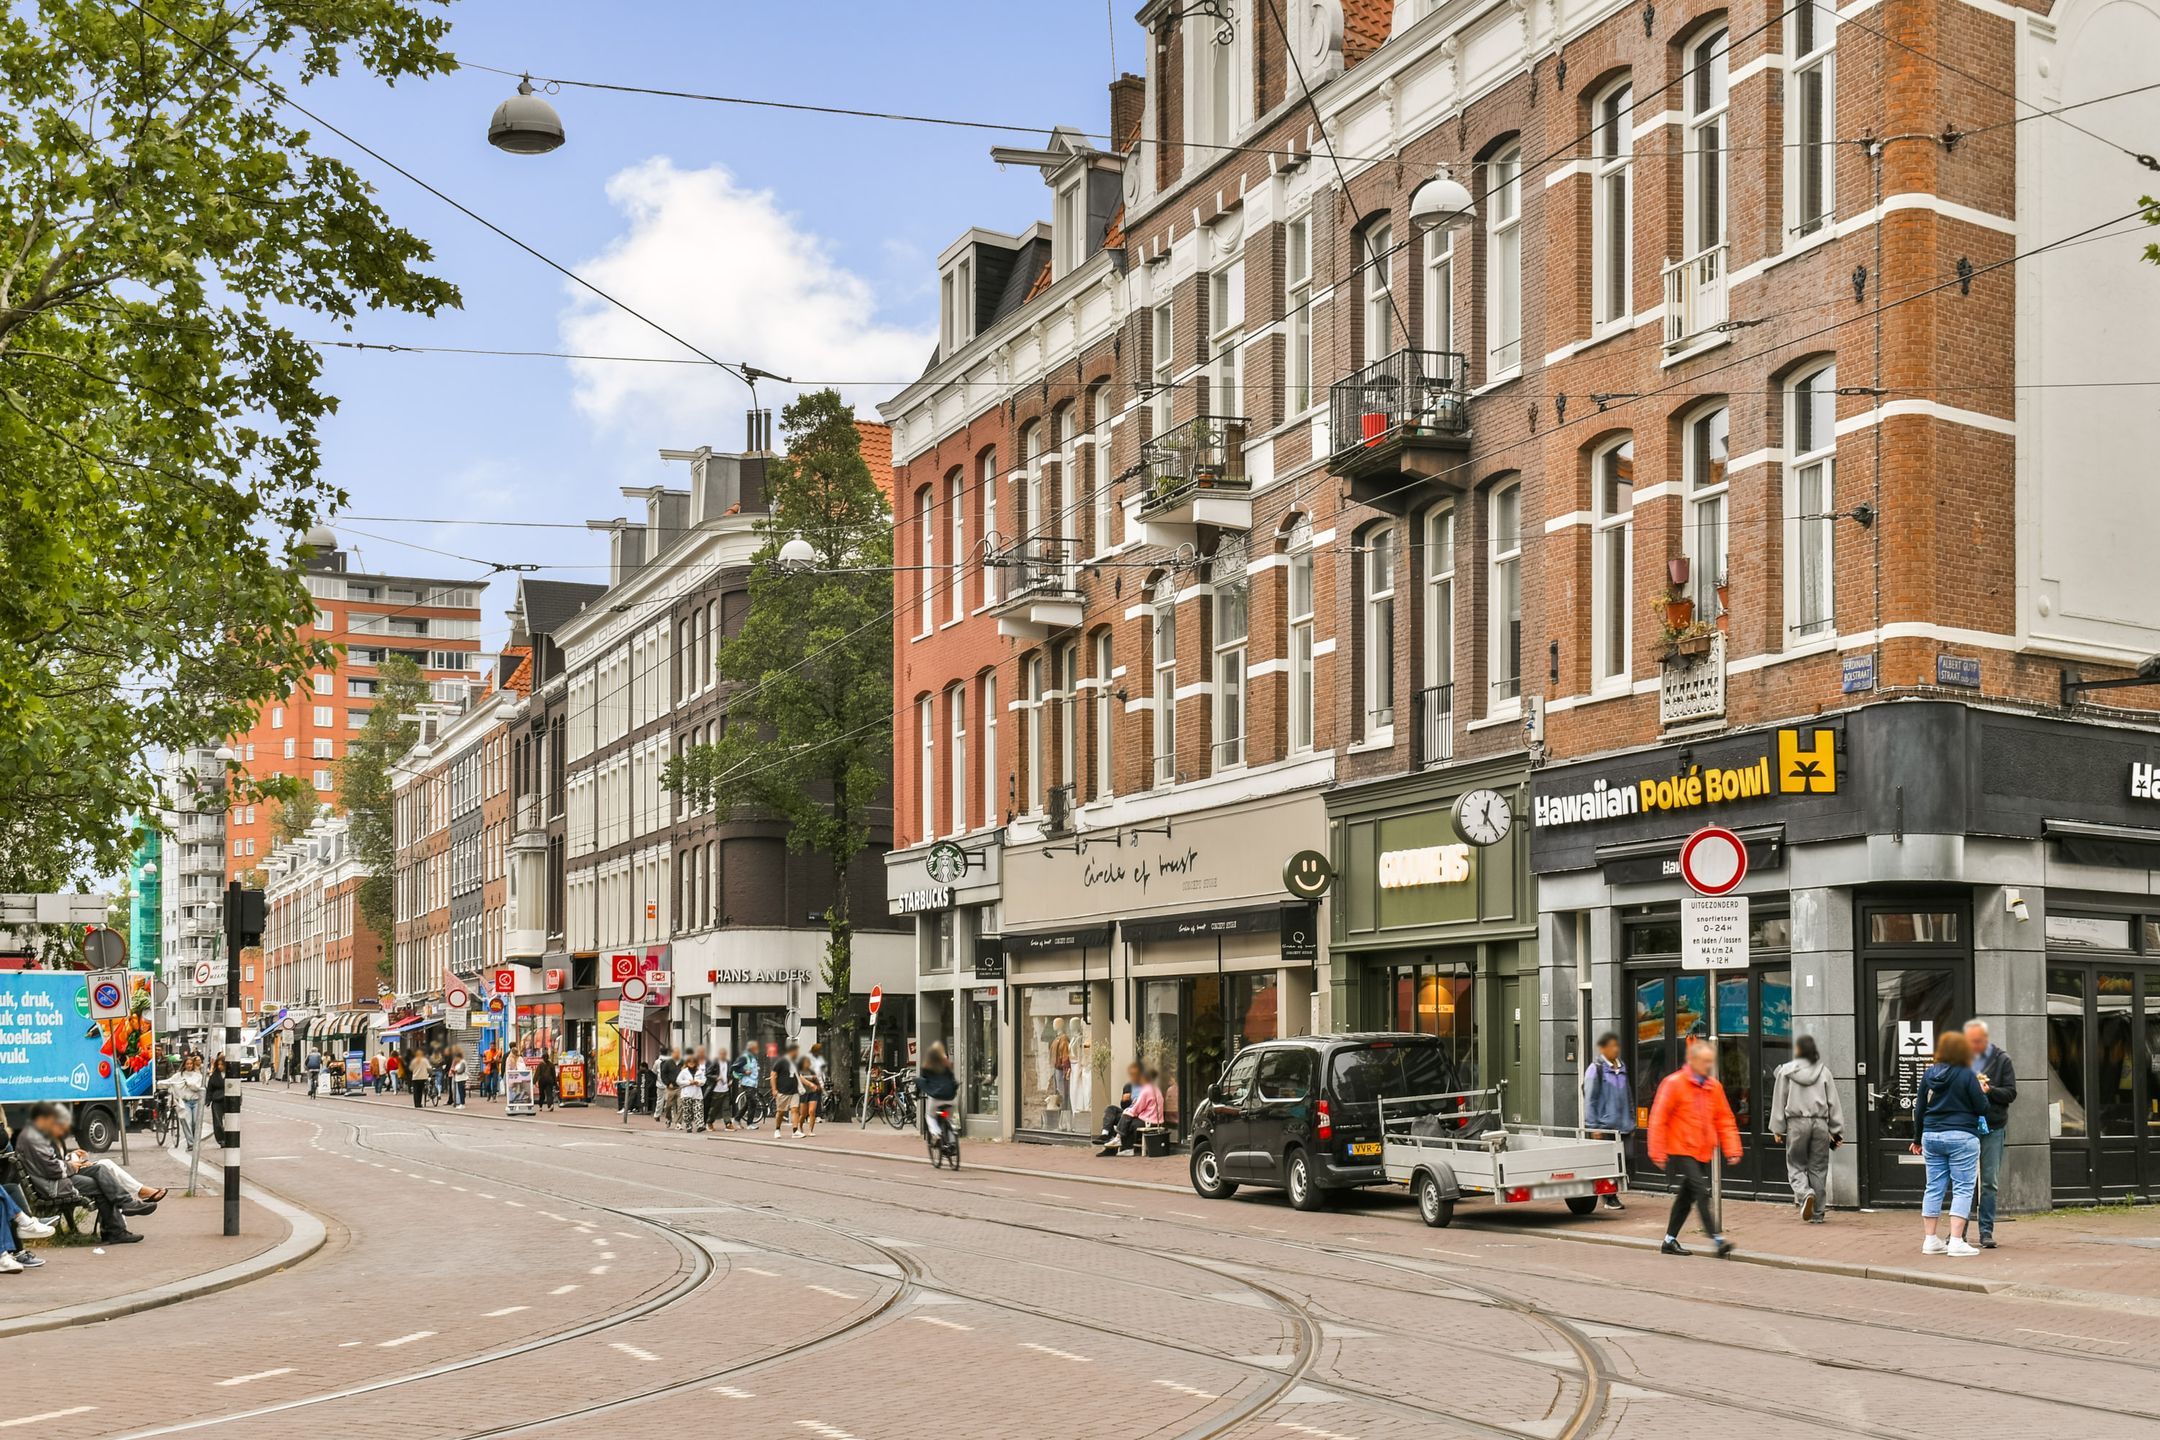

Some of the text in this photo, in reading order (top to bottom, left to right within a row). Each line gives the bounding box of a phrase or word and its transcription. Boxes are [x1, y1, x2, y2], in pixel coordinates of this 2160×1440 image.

[1843, 658, 1871, 671] FERDINAND
[1942, 659, 1977, 672] ALBERT CUYP
[1844, 669, 1870, 682] BOLSTRAAT
[1941, 670, 1960, 680] STRAAT
[1640, 764, 1702, 813] Poké
[1704, 756, 1771, 803] Bowl
[1084, 846, 1198, 895] Circle of trust
[899, 886, 949, 913] STARBUCKS
[1691, 901, 1739, 909] UITGEZONDERD
[1723, 936, 1742, 944] lossen
[716, 968, 812, 983] HANS ANDERS
[21, 991, 54, 1010] druk,
[17, 1013, 33, 1026] en
[35, 1009, 63, 1026] toch
[0, 1029, 52, 1045] koelkast
